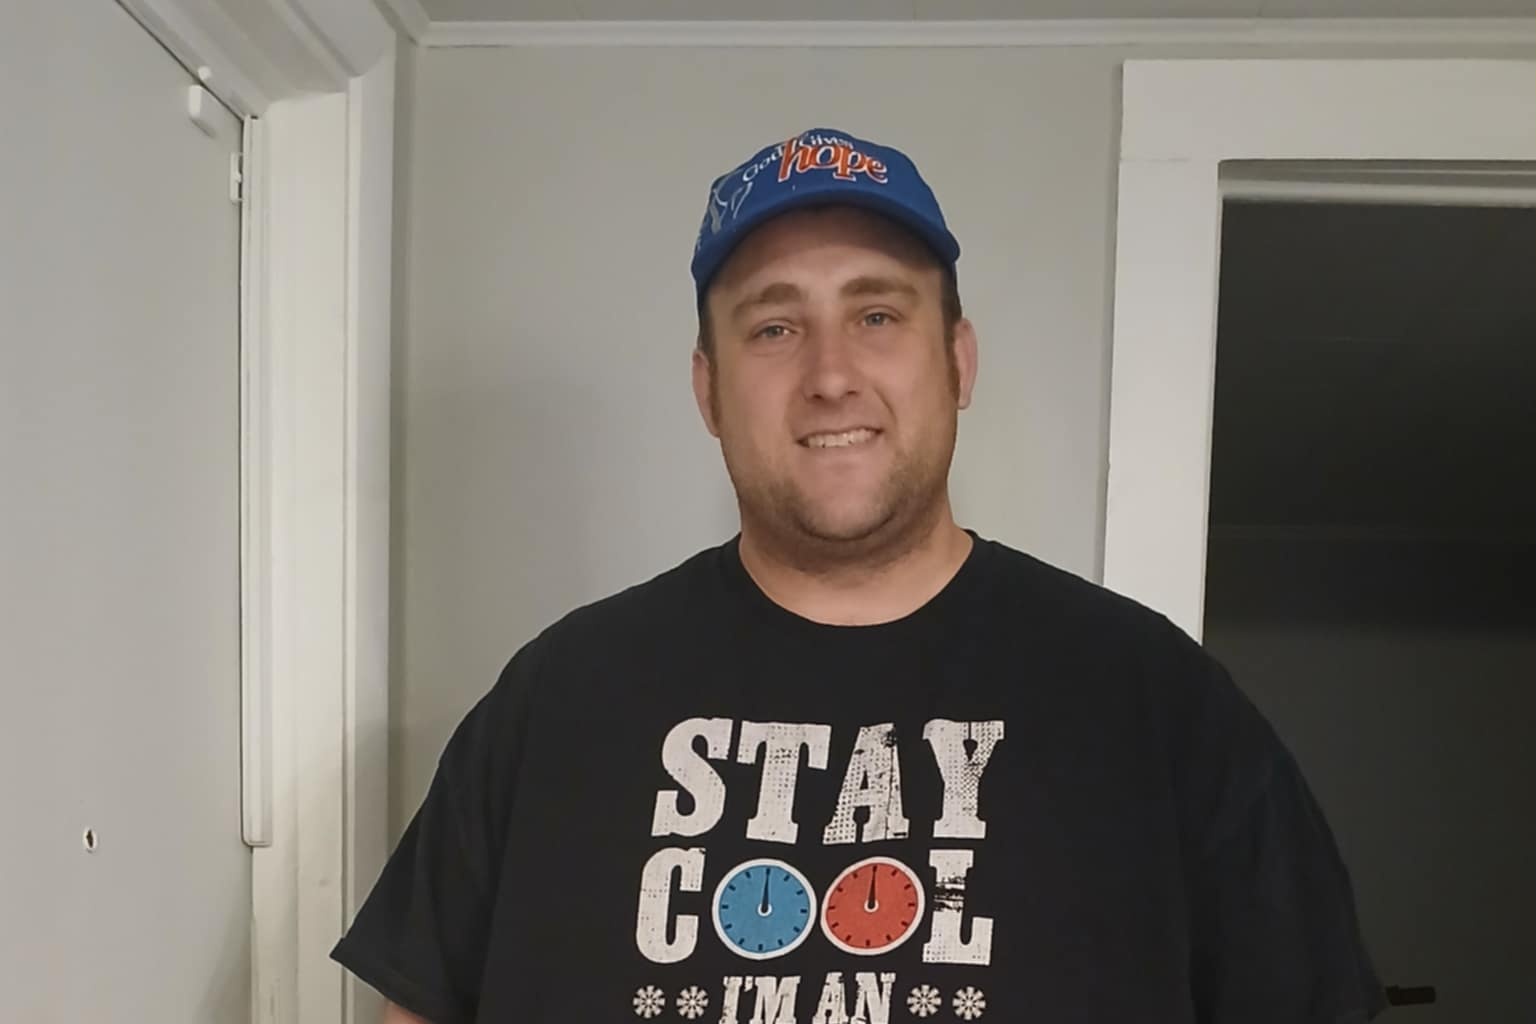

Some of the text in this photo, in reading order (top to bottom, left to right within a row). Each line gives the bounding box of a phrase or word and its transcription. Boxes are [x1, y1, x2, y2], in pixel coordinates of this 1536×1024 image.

[778, 138, 888, 184] hope
[651, 717, 1005, 845] STAY
[636, 847, 994, 966] COOL
